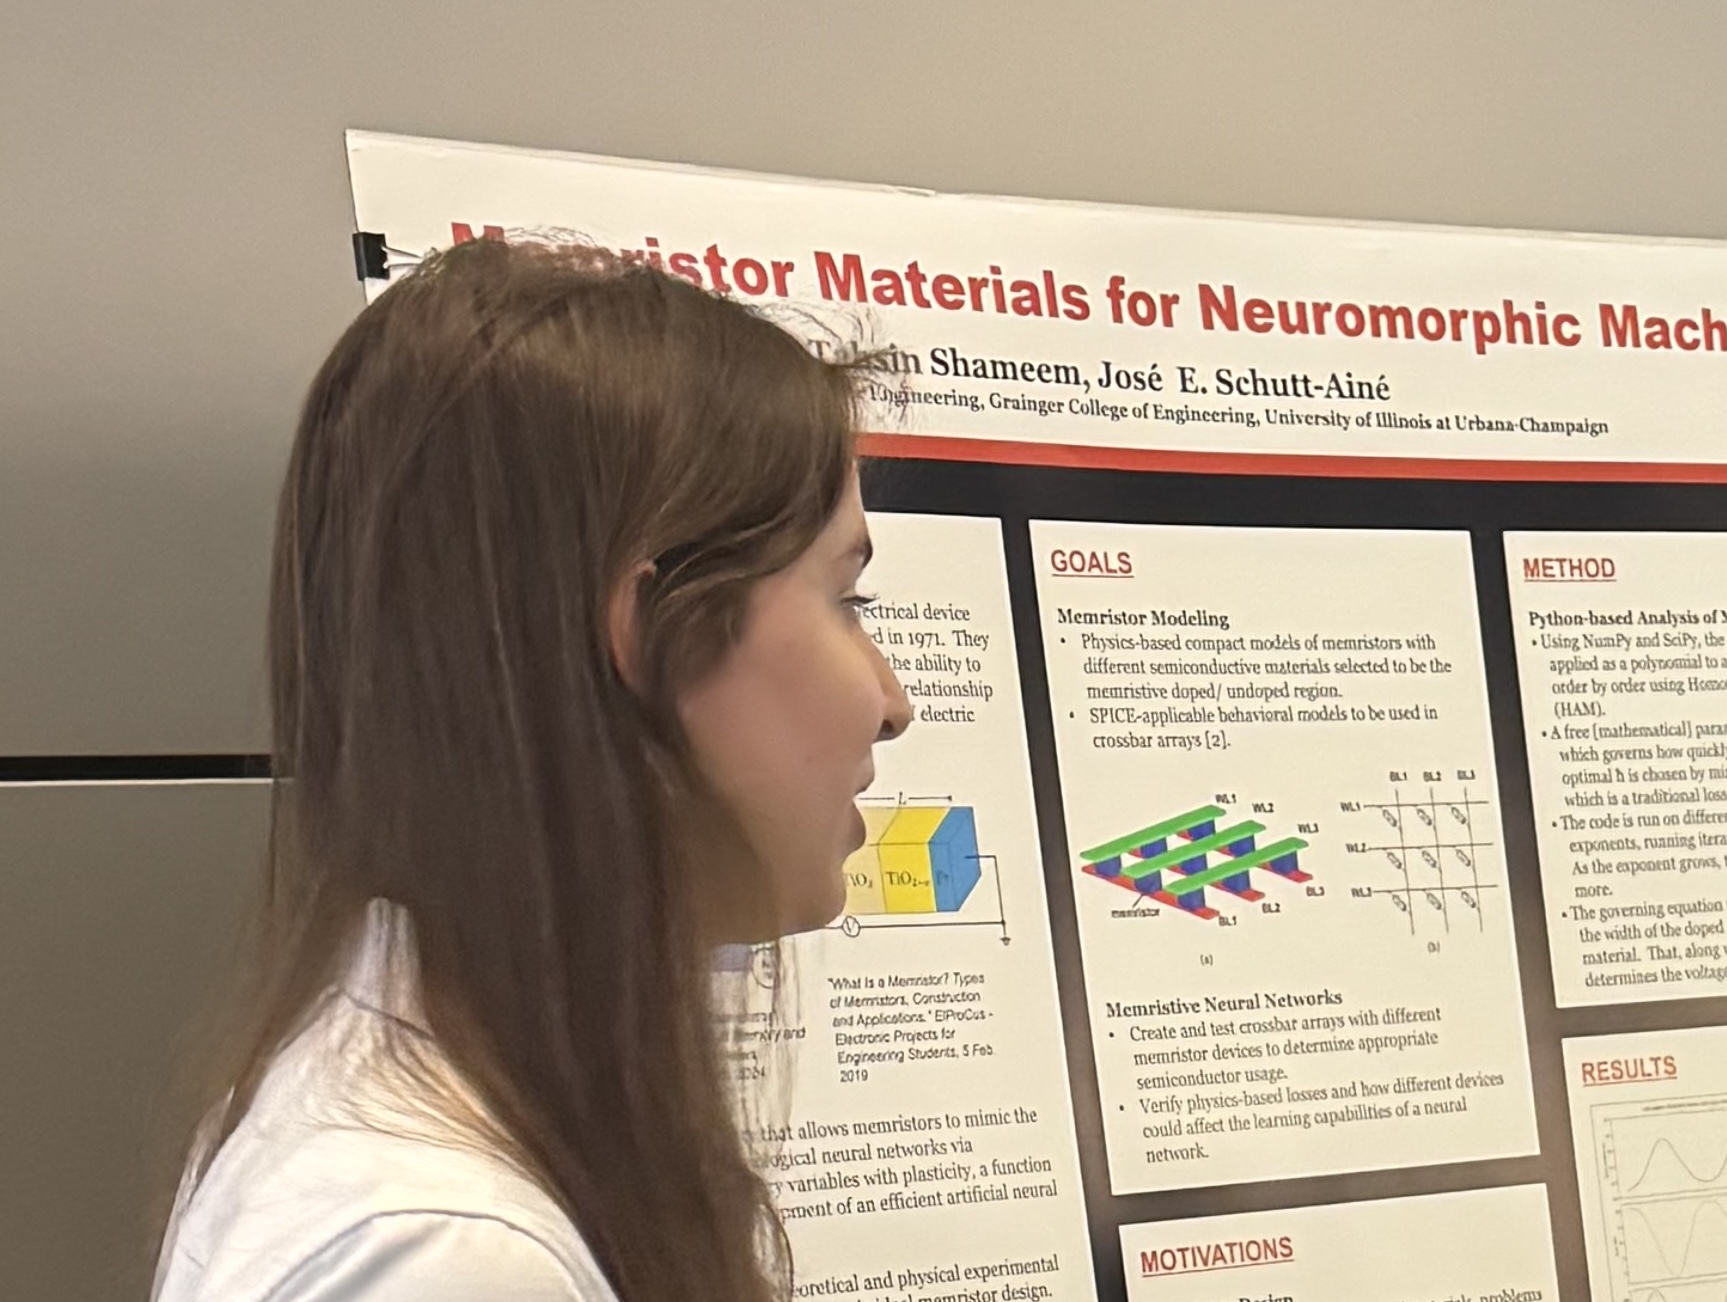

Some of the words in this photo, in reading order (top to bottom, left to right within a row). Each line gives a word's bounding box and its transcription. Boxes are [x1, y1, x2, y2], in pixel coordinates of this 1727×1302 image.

[815, 251, 1090, 321] Materials
[1105, 274, 1180, 327] for
[1198, 285, 1581, 354] Neuromorphic
[930, 346, 1090, 394] Shameem,
[1097, 360, 1163, 391] José
[1179, 366, 1207, 394] E.
[1215, 368, 1390, 400] Schutt-Ainé
[869, 382, 986, 413] Engineering,
[988, 392, 1064, 416] Grainger
[1068, 398, 1128, 421] College
[1131, 402, 1149, 419] of
[1152, 403, 1260, 427] Engineering,
[1264, 408, 1351, 431] University
[1355, 411, 1372, 427] of
[1375, 411, 1432, 429] Illinois
[1435, 416, 1451, 430] at
[1454, 414, 1608, 437] Urbana-Champaign
[1050, 549, 1133, 575] GOALS
[1523, 557, 1616, 579] METHOD
[922, 603, 970, 621] device
[1057, 608, 1147, 625] Memristor
[1150, 610, 1229, 630] Modeling
[1528, 609, 1633, 629] Python-based
[1637, 609, 1699, 628] Analysis
[1702, 609, 1717, 623] of
[887, 627, 903, 644] in
[907, 632, 945, 648] 1971.
[951, 628, 989, 651] They
[1081, 633, 1181, 657] Physics-based
[1184, 636, 1246, 655] compact
[1249, 633, 1301, 650] models
[1304, 633, 1318, 651] of
[1321, 633, 1402, 650] memristors
[1405, 633, 1435, 650] with
[915, 653, 961, 676] ability
[965, 656, 981, 672] to
[1083, 658, 1146, 674] different
[1149, 657, 1260, 675] semiconductive
[1264, 657, 1331, 674] materials
[1333, 657, 1389, 673] selected
[1392, 659, 1407, 673] to
[1408, 657, 1426, 673] be
[1429, 657, 1451, 673] the
[1086, 682, 1167, 699] memristive
[1226, 681, 1290, 702] undoped
[1293, 681, 1343, 701] region.
[920, 705, 975, 722] electric
[1089, 706, 1214, 727] SPICE-applicable
[1216, 704, 1293, 722] behavioral
[1297, 704, 1348, 721] models
[1350, 706, 1365, 721] to
[1367, 704, 1385, 720] be
[1388, 703, 1420, 720] used
[1423, 703, 1438, 719] in
[1554, 701, 1605, 718] (HAM).
[1092, 732, 1152, 748] crossbar
[1156, 735, 1202, 751] arrays
[1204, 731, 1231, 750] [2].
[1574, 884, 1613, 897] more.
[1106, 998, 1200, 1018] Memristive
[1204, 993, 1260, 1012] Neural
[1263, 989, 1342, 1008] Networks
[940, 1026, 955, 1039] for
[1136, 1069, 1241, 1090] semiconductor
[1244, 1067, 1287, 1084] usage.
[1581, 1056, 1678, 1084] RESULTS
[761, 1122, 793, 1143] that
[797, 1120, 849, 1139] allows
[852, 1114, 942, 1135] memristors
[945, 1113, 960, 1128] to
[964, 1107, 1011, 1127] mimic
[1013, 1106, 1037, 1123] the
[821, 1143, 872, 1164] neural
[876, 1139, 947, 1159] networks
[950, 1137, 972, 1153] via
[1145, 1142, 1209, 1163] network.
[1140, 1236, 1294, 1273] MOTIVATIONS
[1001, 1283, 1052, 1302] design.
